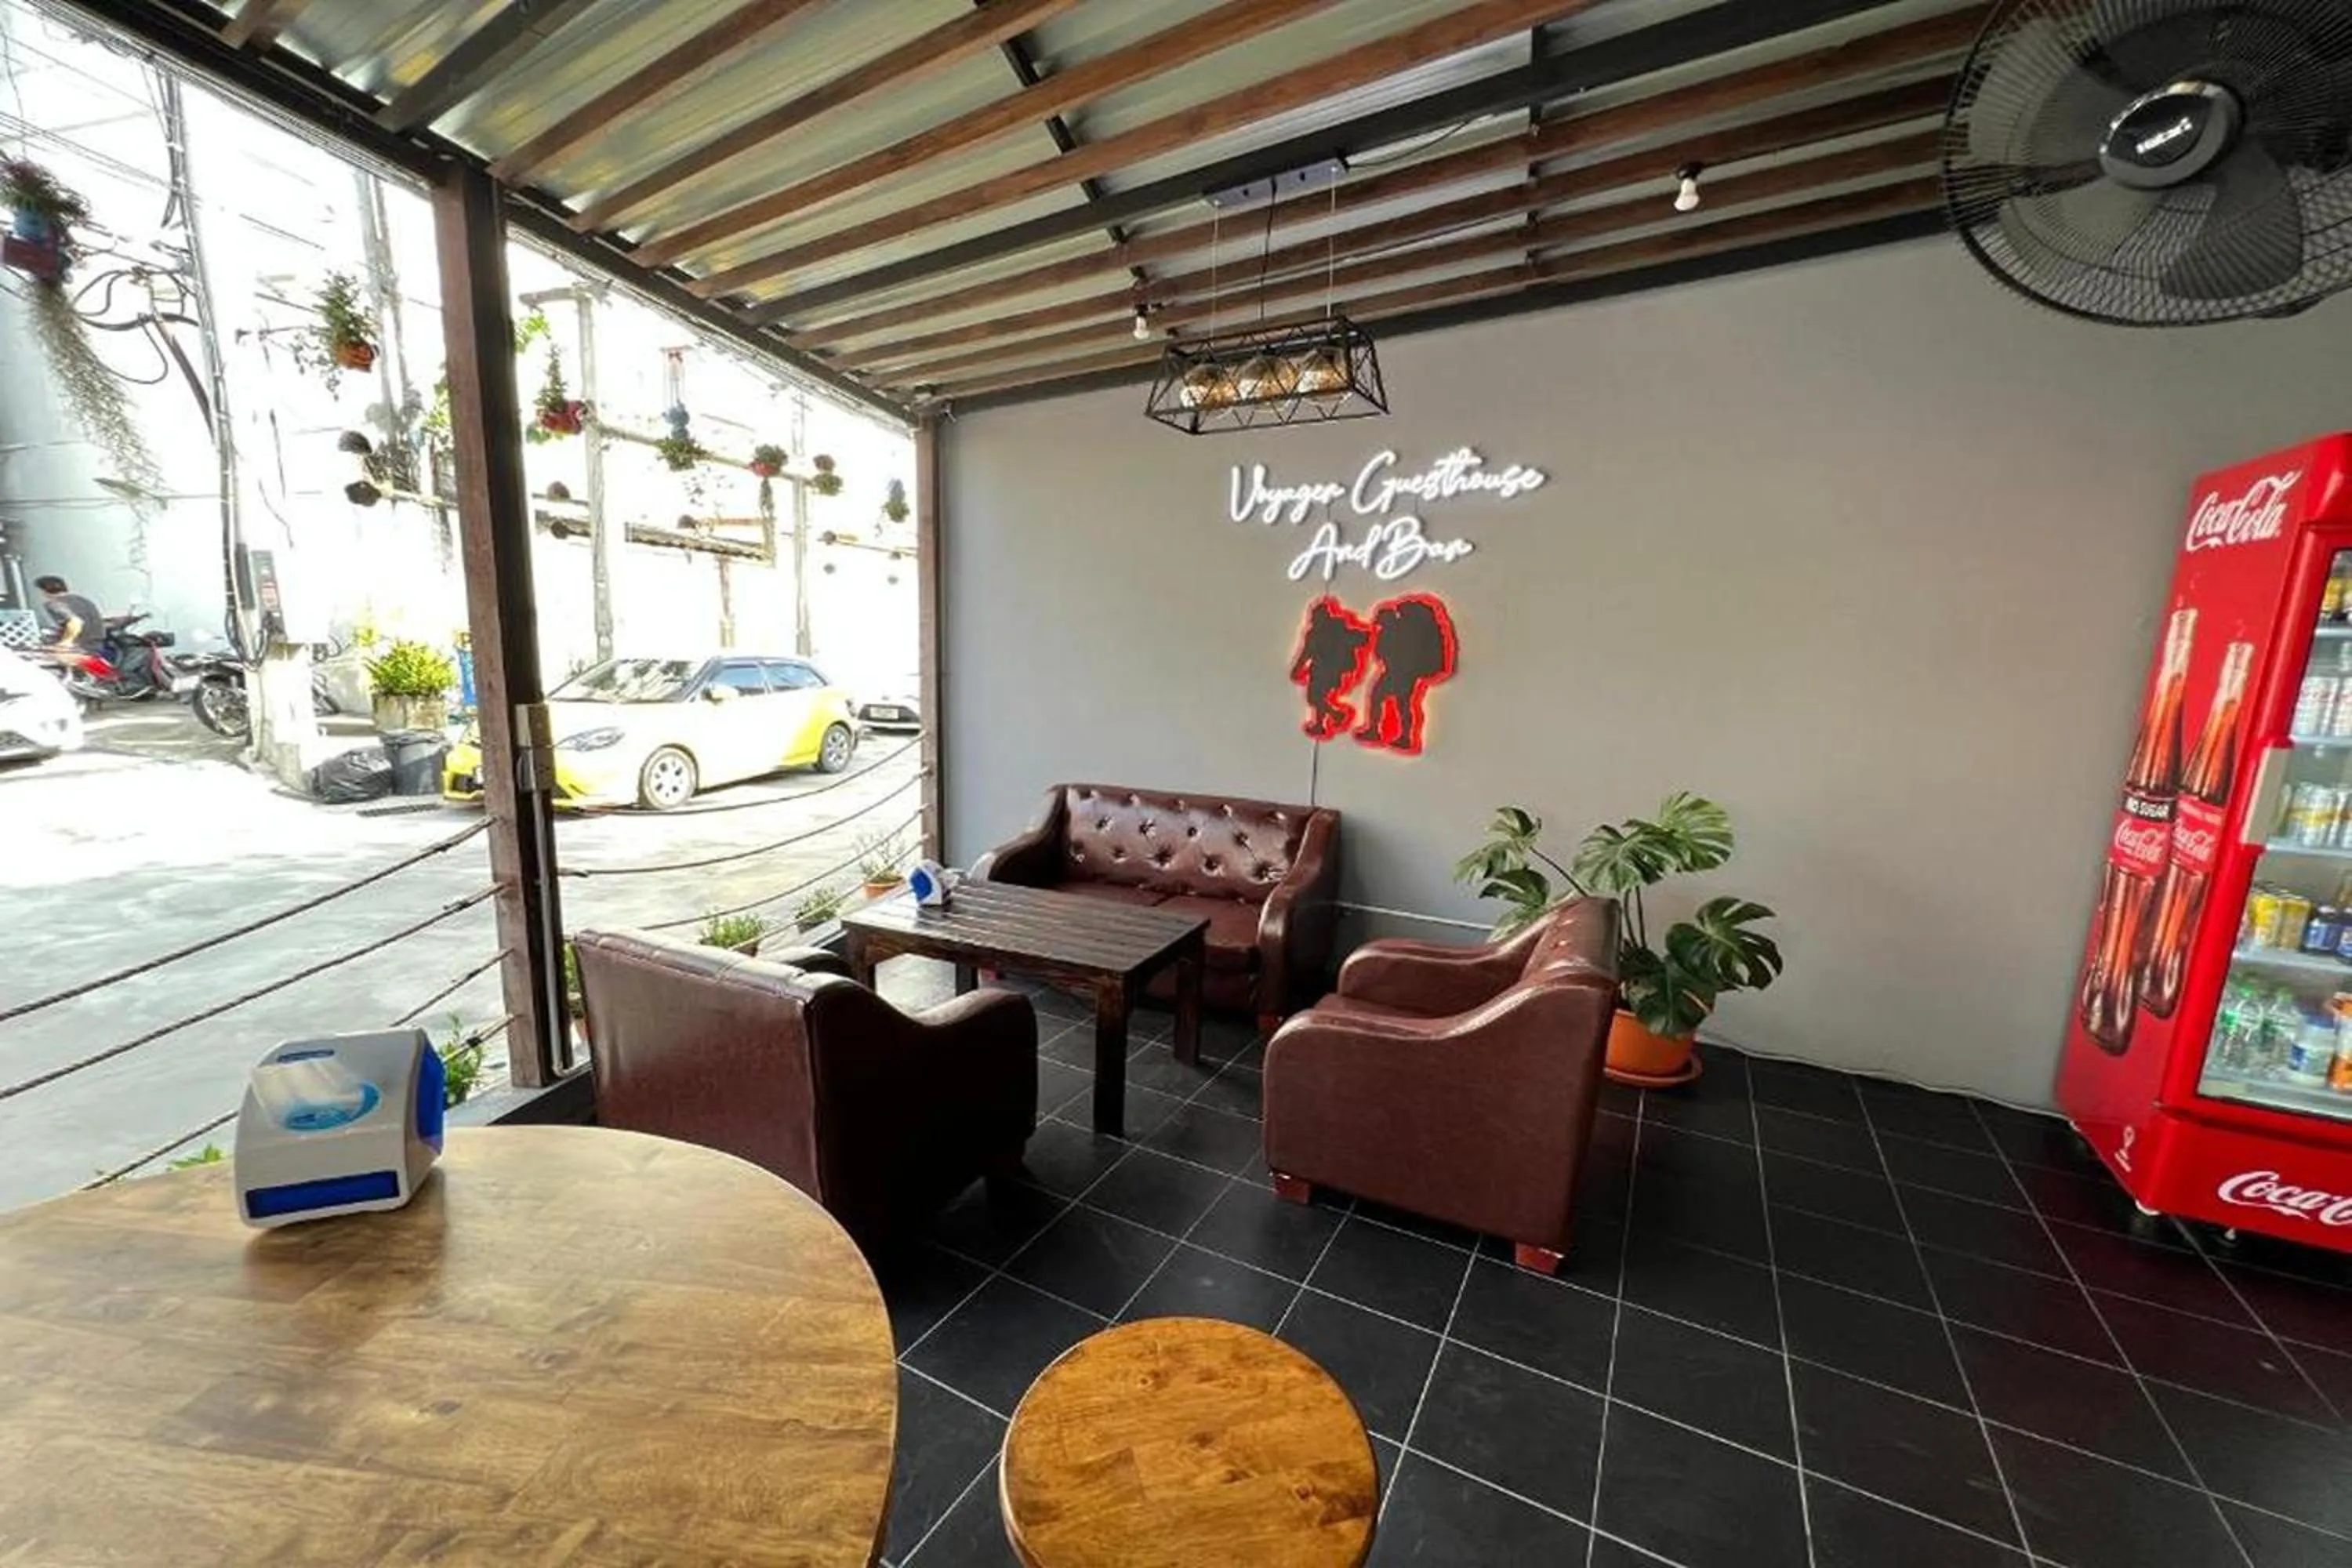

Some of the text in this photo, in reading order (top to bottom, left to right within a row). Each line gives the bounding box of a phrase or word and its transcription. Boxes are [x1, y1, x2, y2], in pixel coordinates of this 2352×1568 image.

[1229, 447, 1544, 523] Voyager Guesthouse
[1287, 516, 1473, 580] And Bar
[2139, 801, 2169, 818] SUGAR
